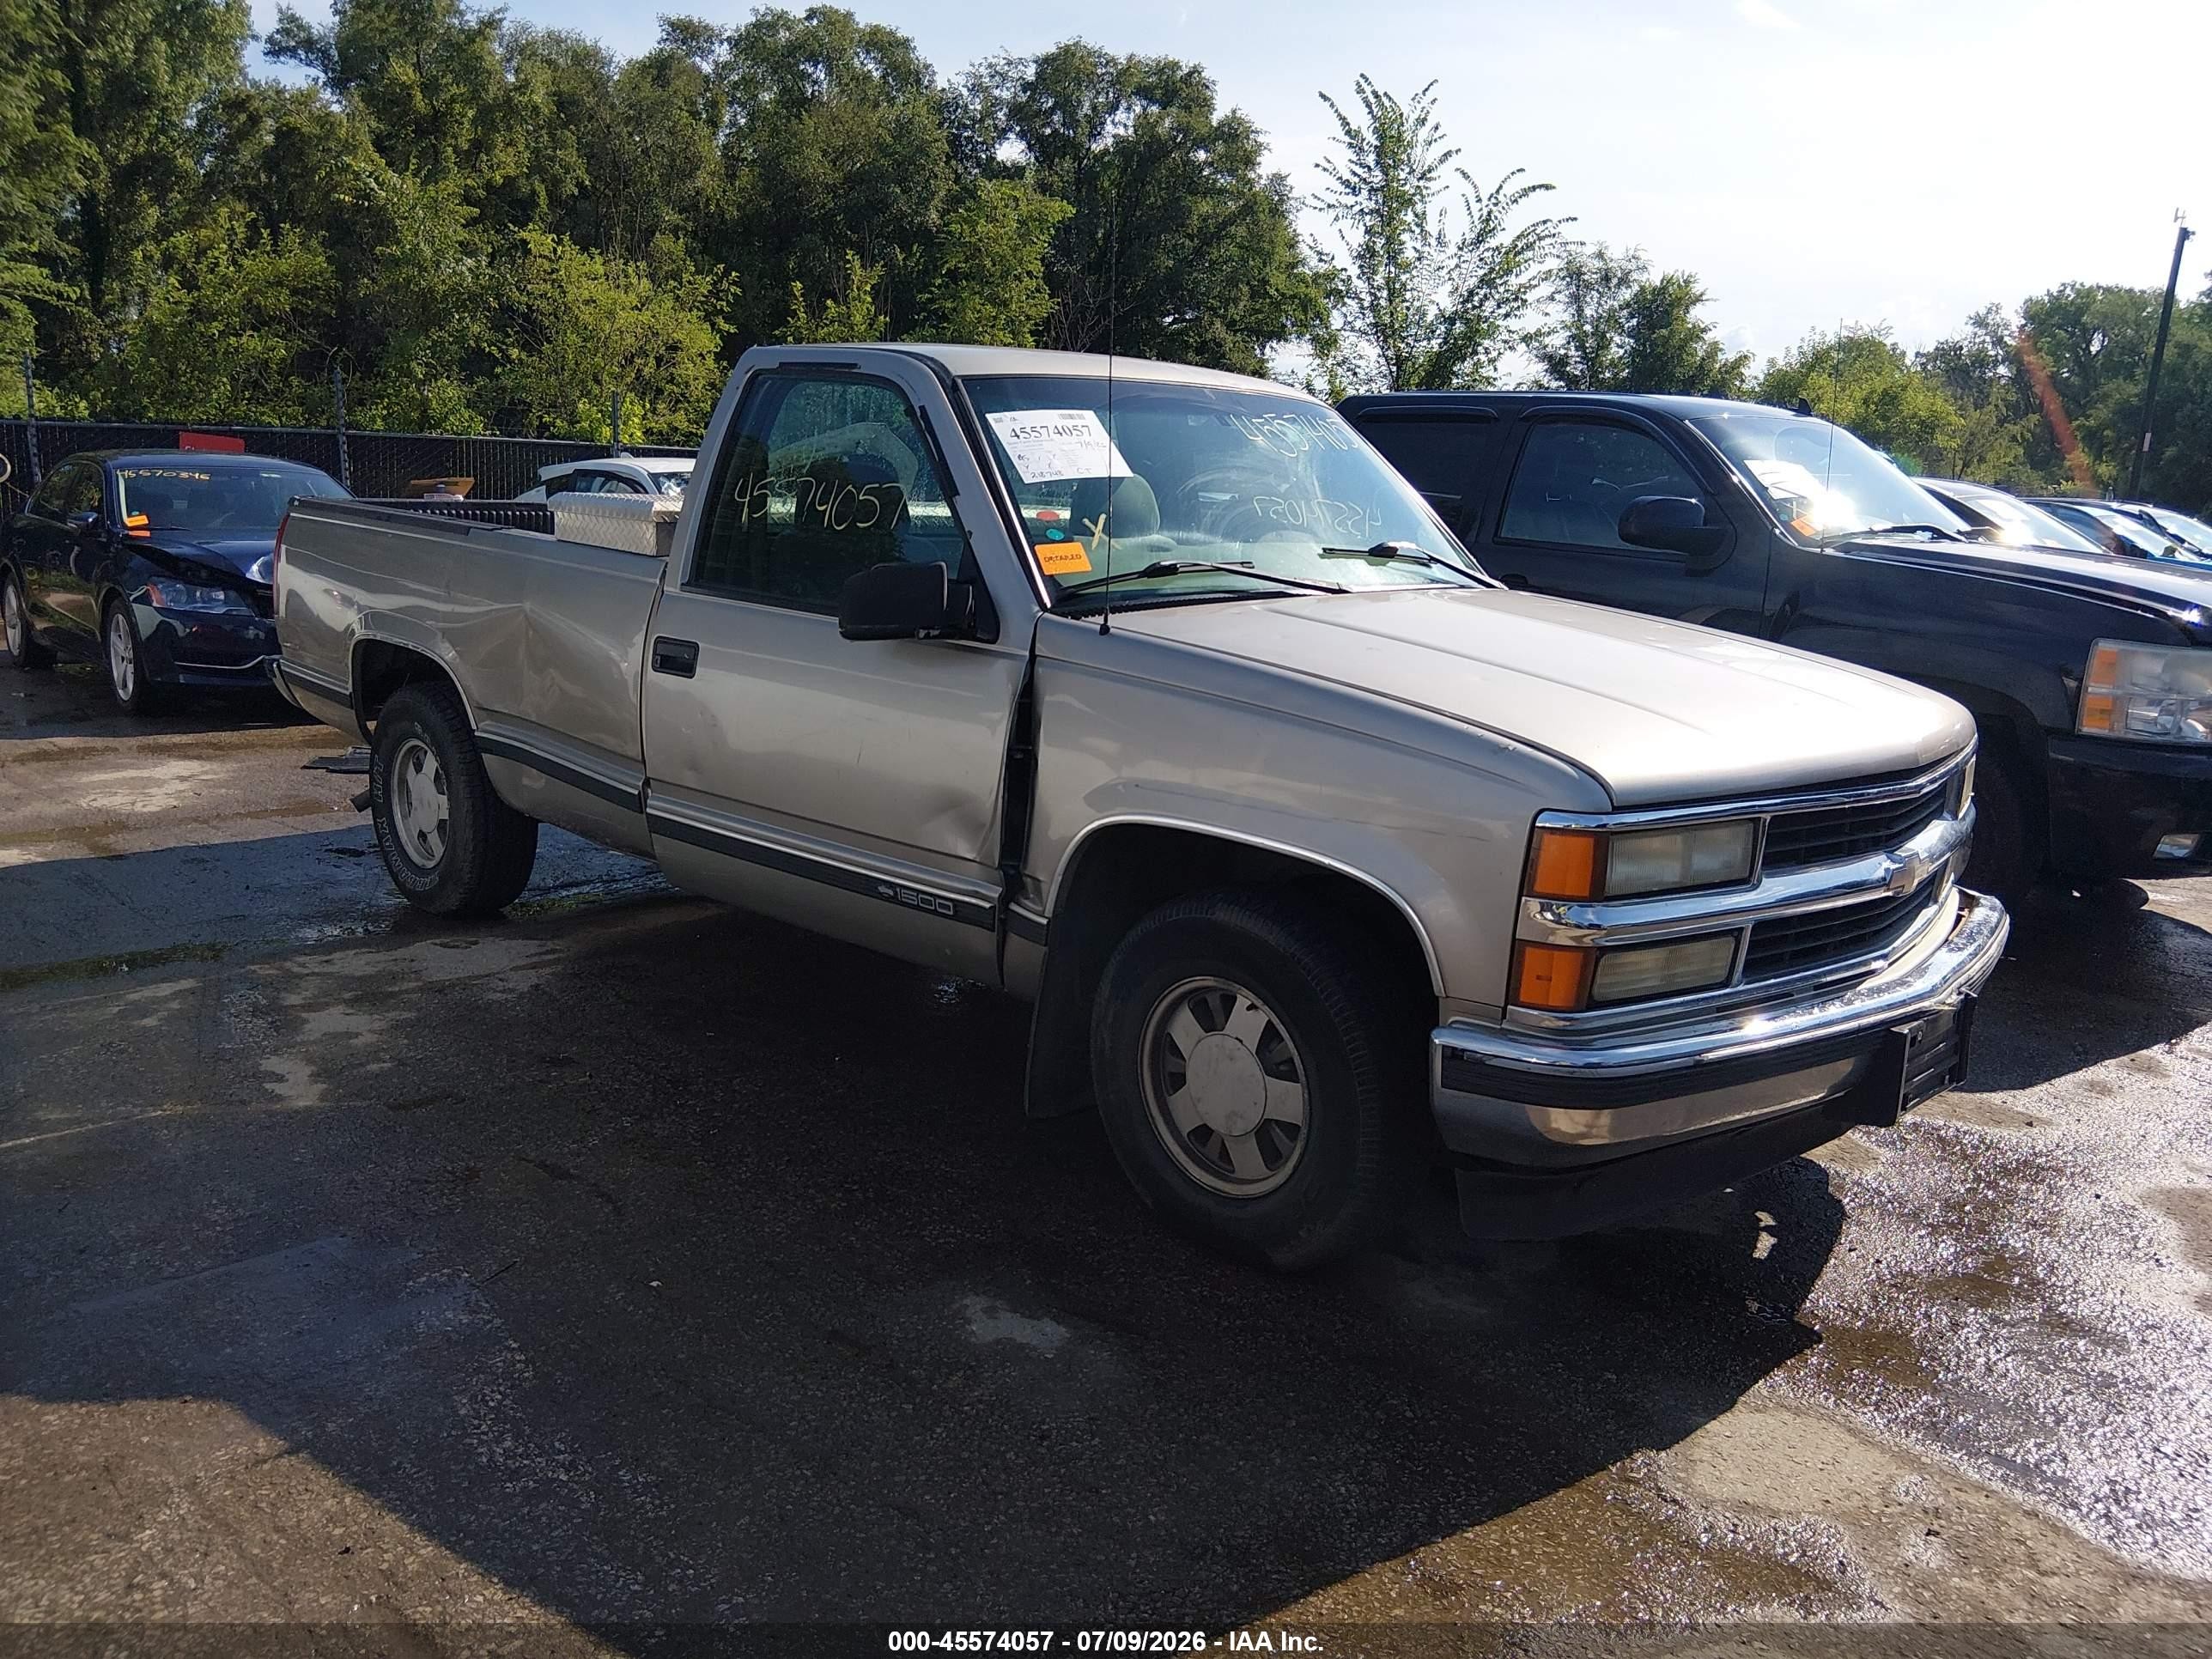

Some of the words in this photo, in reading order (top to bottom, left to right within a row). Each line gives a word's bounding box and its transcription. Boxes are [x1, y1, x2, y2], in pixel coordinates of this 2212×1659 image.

[1009, 424, 1092, 441] 45574057
[734, 471, 908, 531] 45574057
[896, 887, 954, 916] 1500
